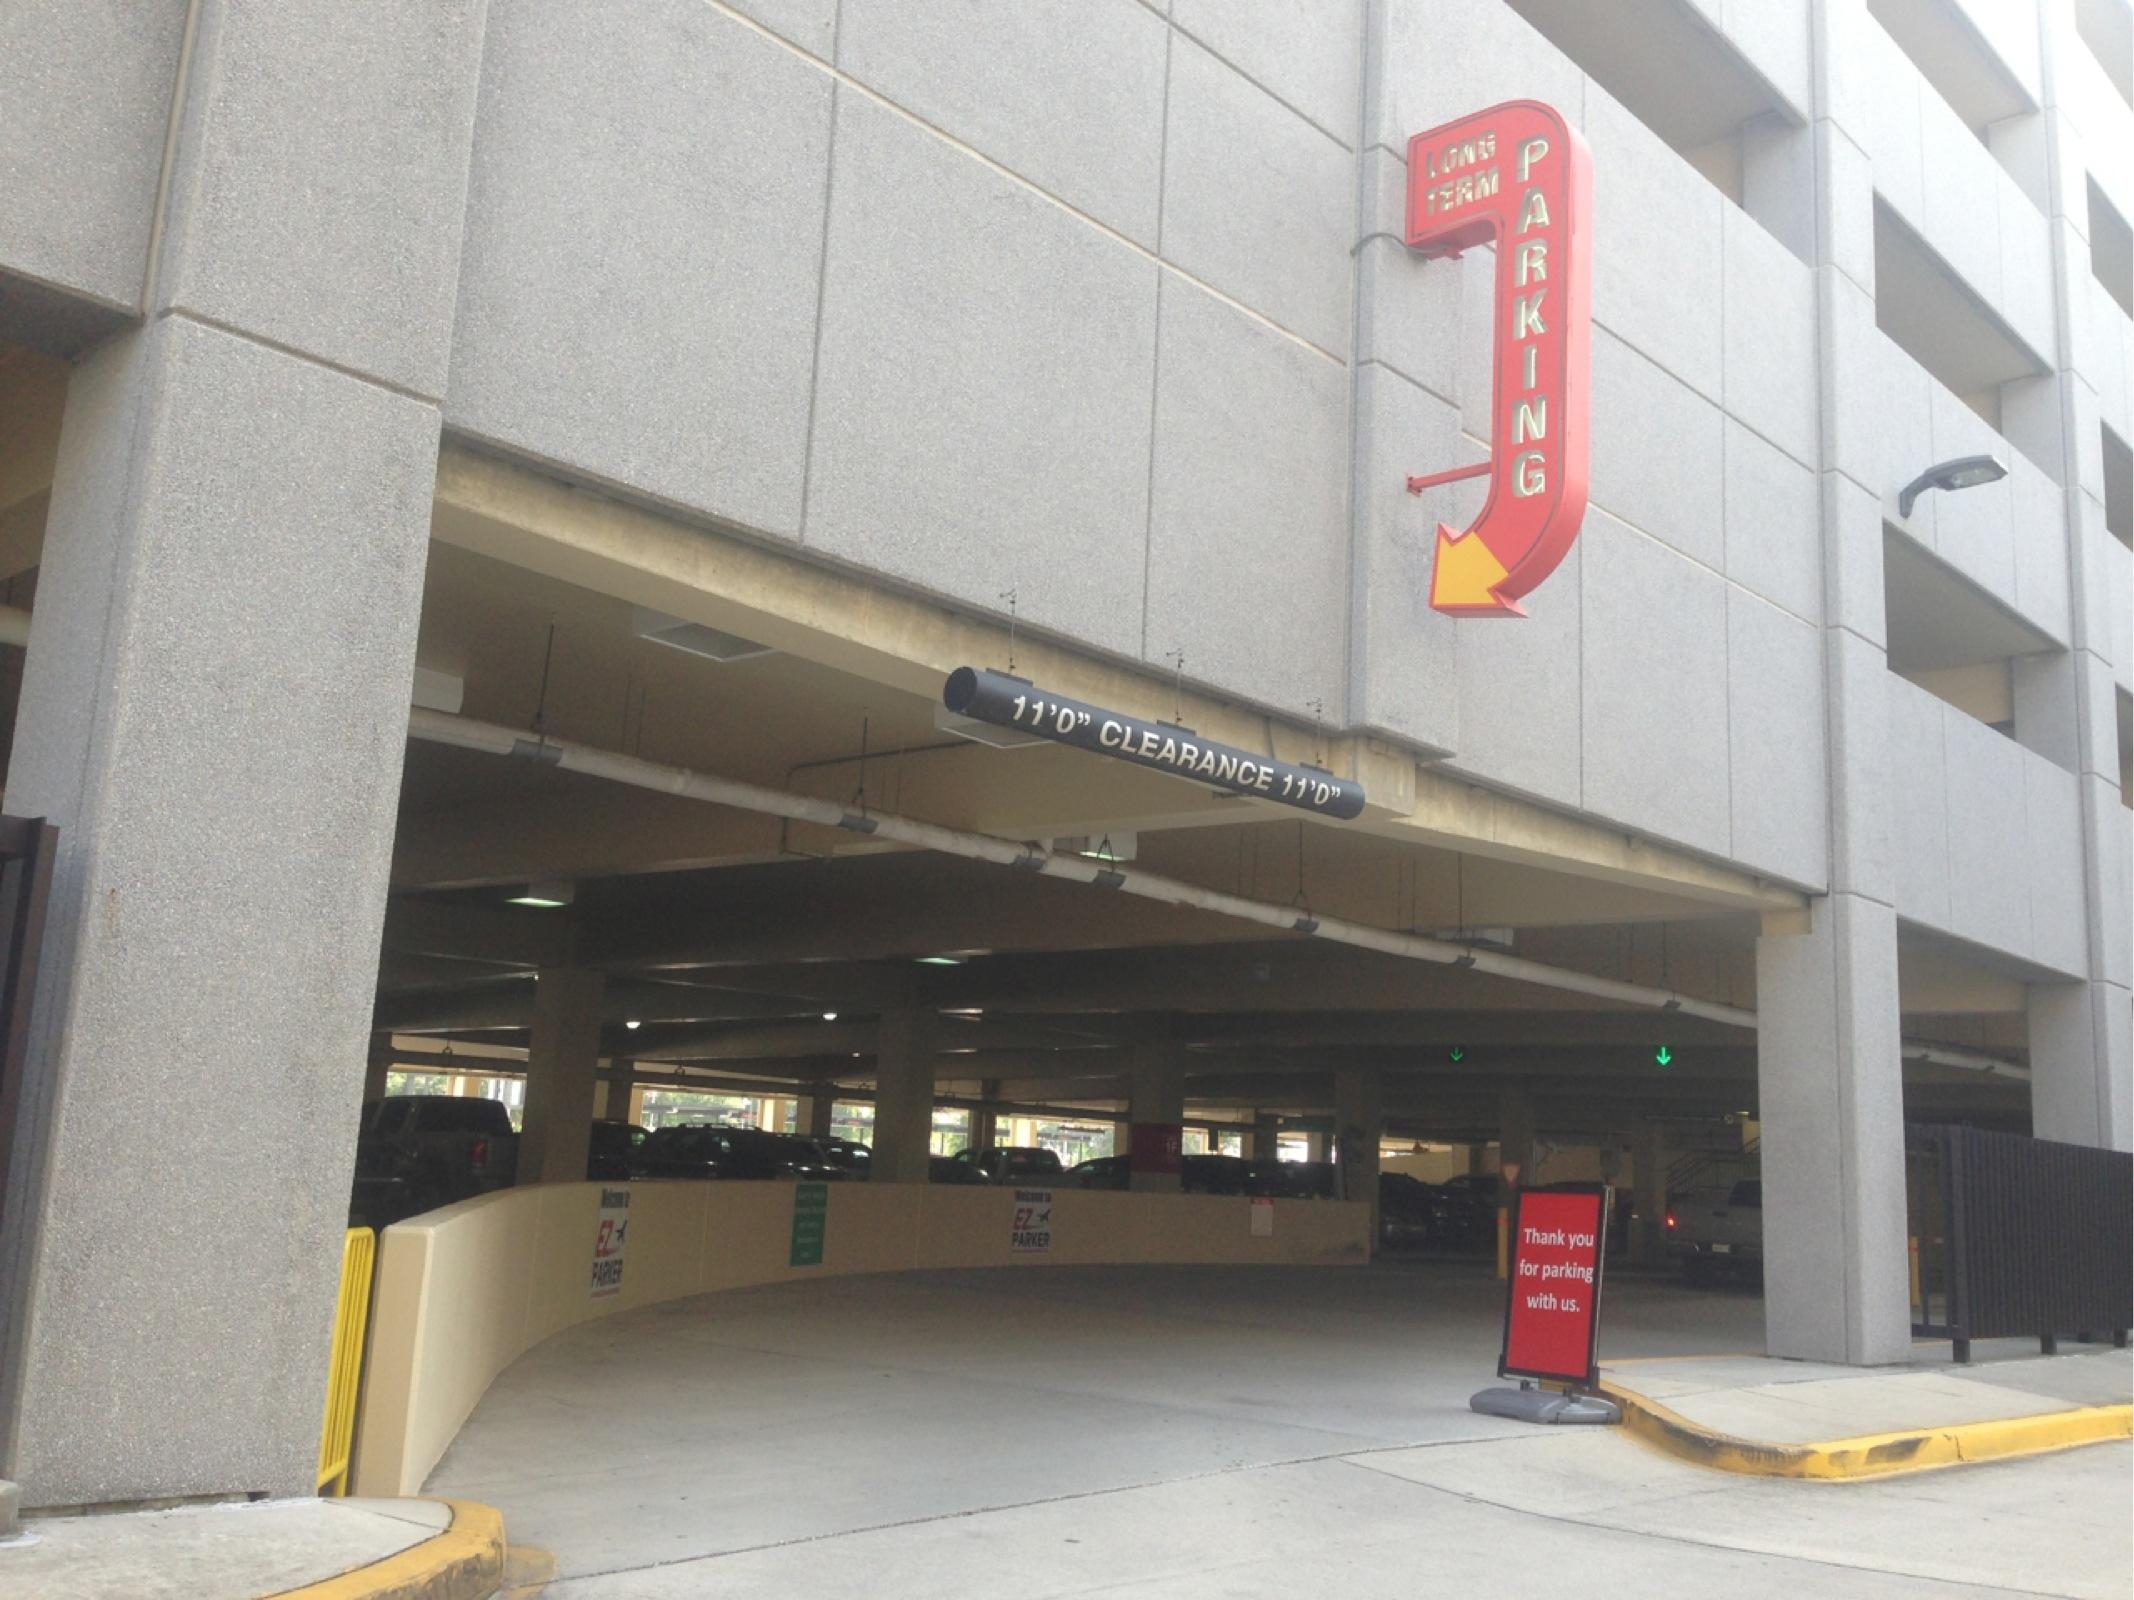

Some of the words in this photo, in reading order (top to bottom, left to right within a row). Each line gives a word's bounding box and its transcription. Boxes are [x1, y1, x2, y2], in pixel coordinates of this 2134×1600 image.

[1425, 129, 1497, 179] LONG
[1424, 168, 1499, 217] TERM
[1512, 137, 1550, 499] PARKING
[1099, 719, 1274, 791] CLEARANCE
[1013, 1207, 1034, 1230] EZ
[595, 1219, 621, 1258] EZ
[1012, 1232, 1051, 1248] PARKER
[1523, 1228, 1565, 1246] Thank
[1568, 1232, 1594, 1250] you
[591, 1258, 624, 1288] PARKER
[1519, 1259, 1538, 1276] for
[1541, 1261, 1594, 1283] parking
[1526, 1293, 1557, 1311] with
[1561, 1298, 1581, 1313] us.
